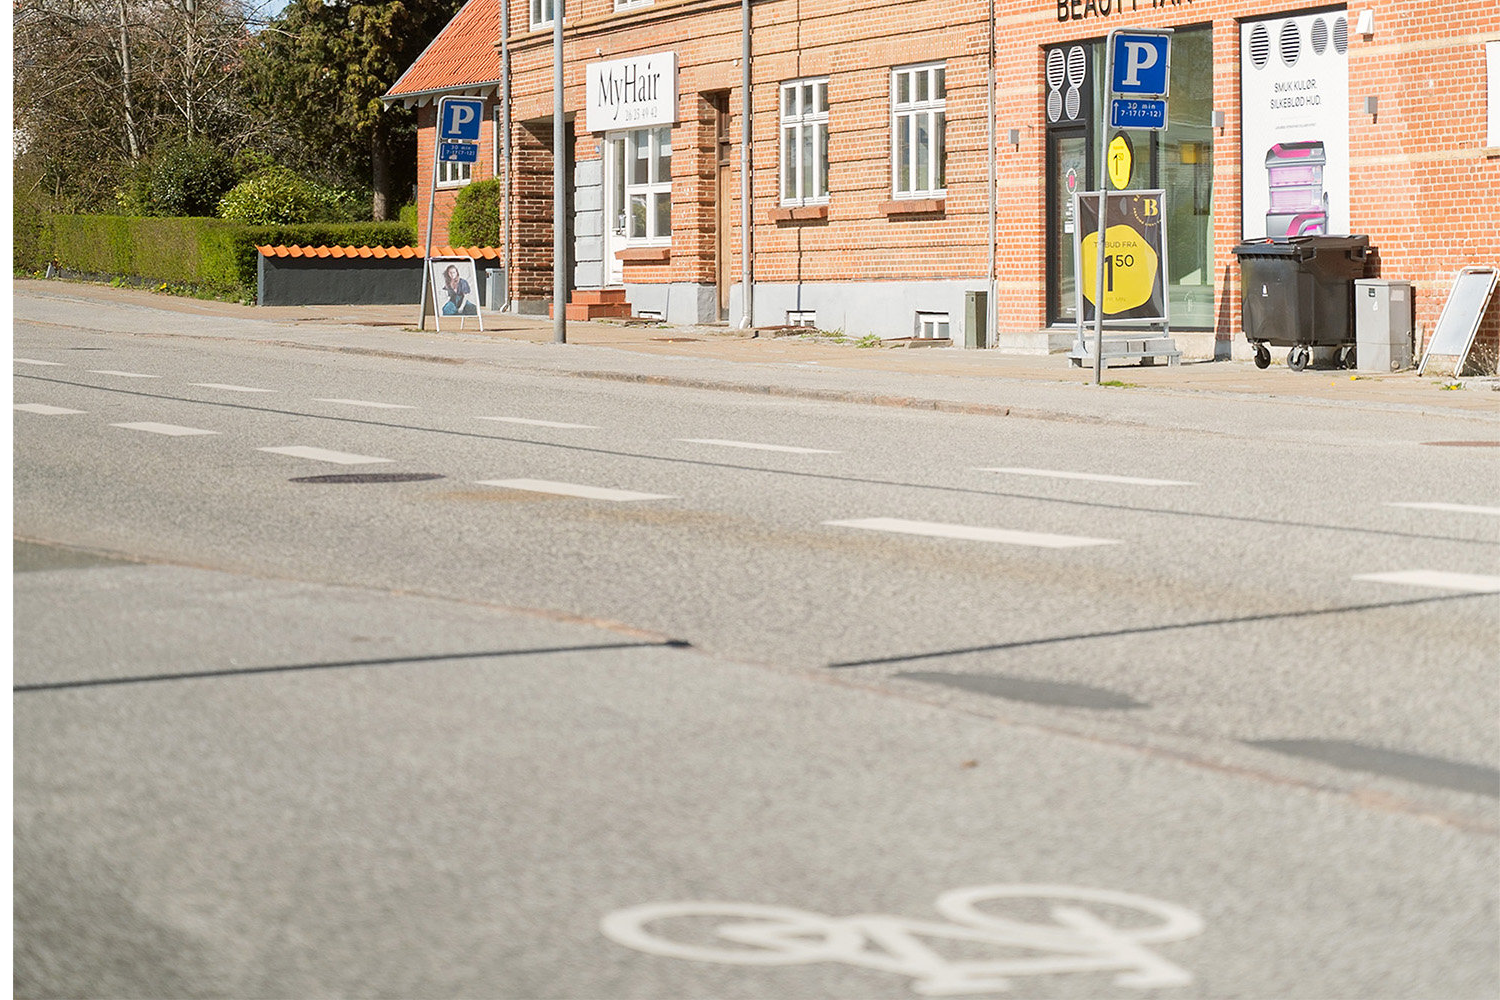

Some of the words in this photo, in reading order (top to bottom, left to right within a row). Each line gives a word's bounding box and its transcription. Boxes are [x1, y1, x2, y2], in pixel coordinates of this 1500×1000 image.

[1122, 42, 1158, 85] P
[1127, 102, 1138, 110] 30
[1141, 102, 1156, 110] min
[448, 105, 475, 134] P
[1143, 198, 1159, 216] B
[1093, 241, 1121, 249] TBUD
[1122, 240, 1138, 248] FRA
